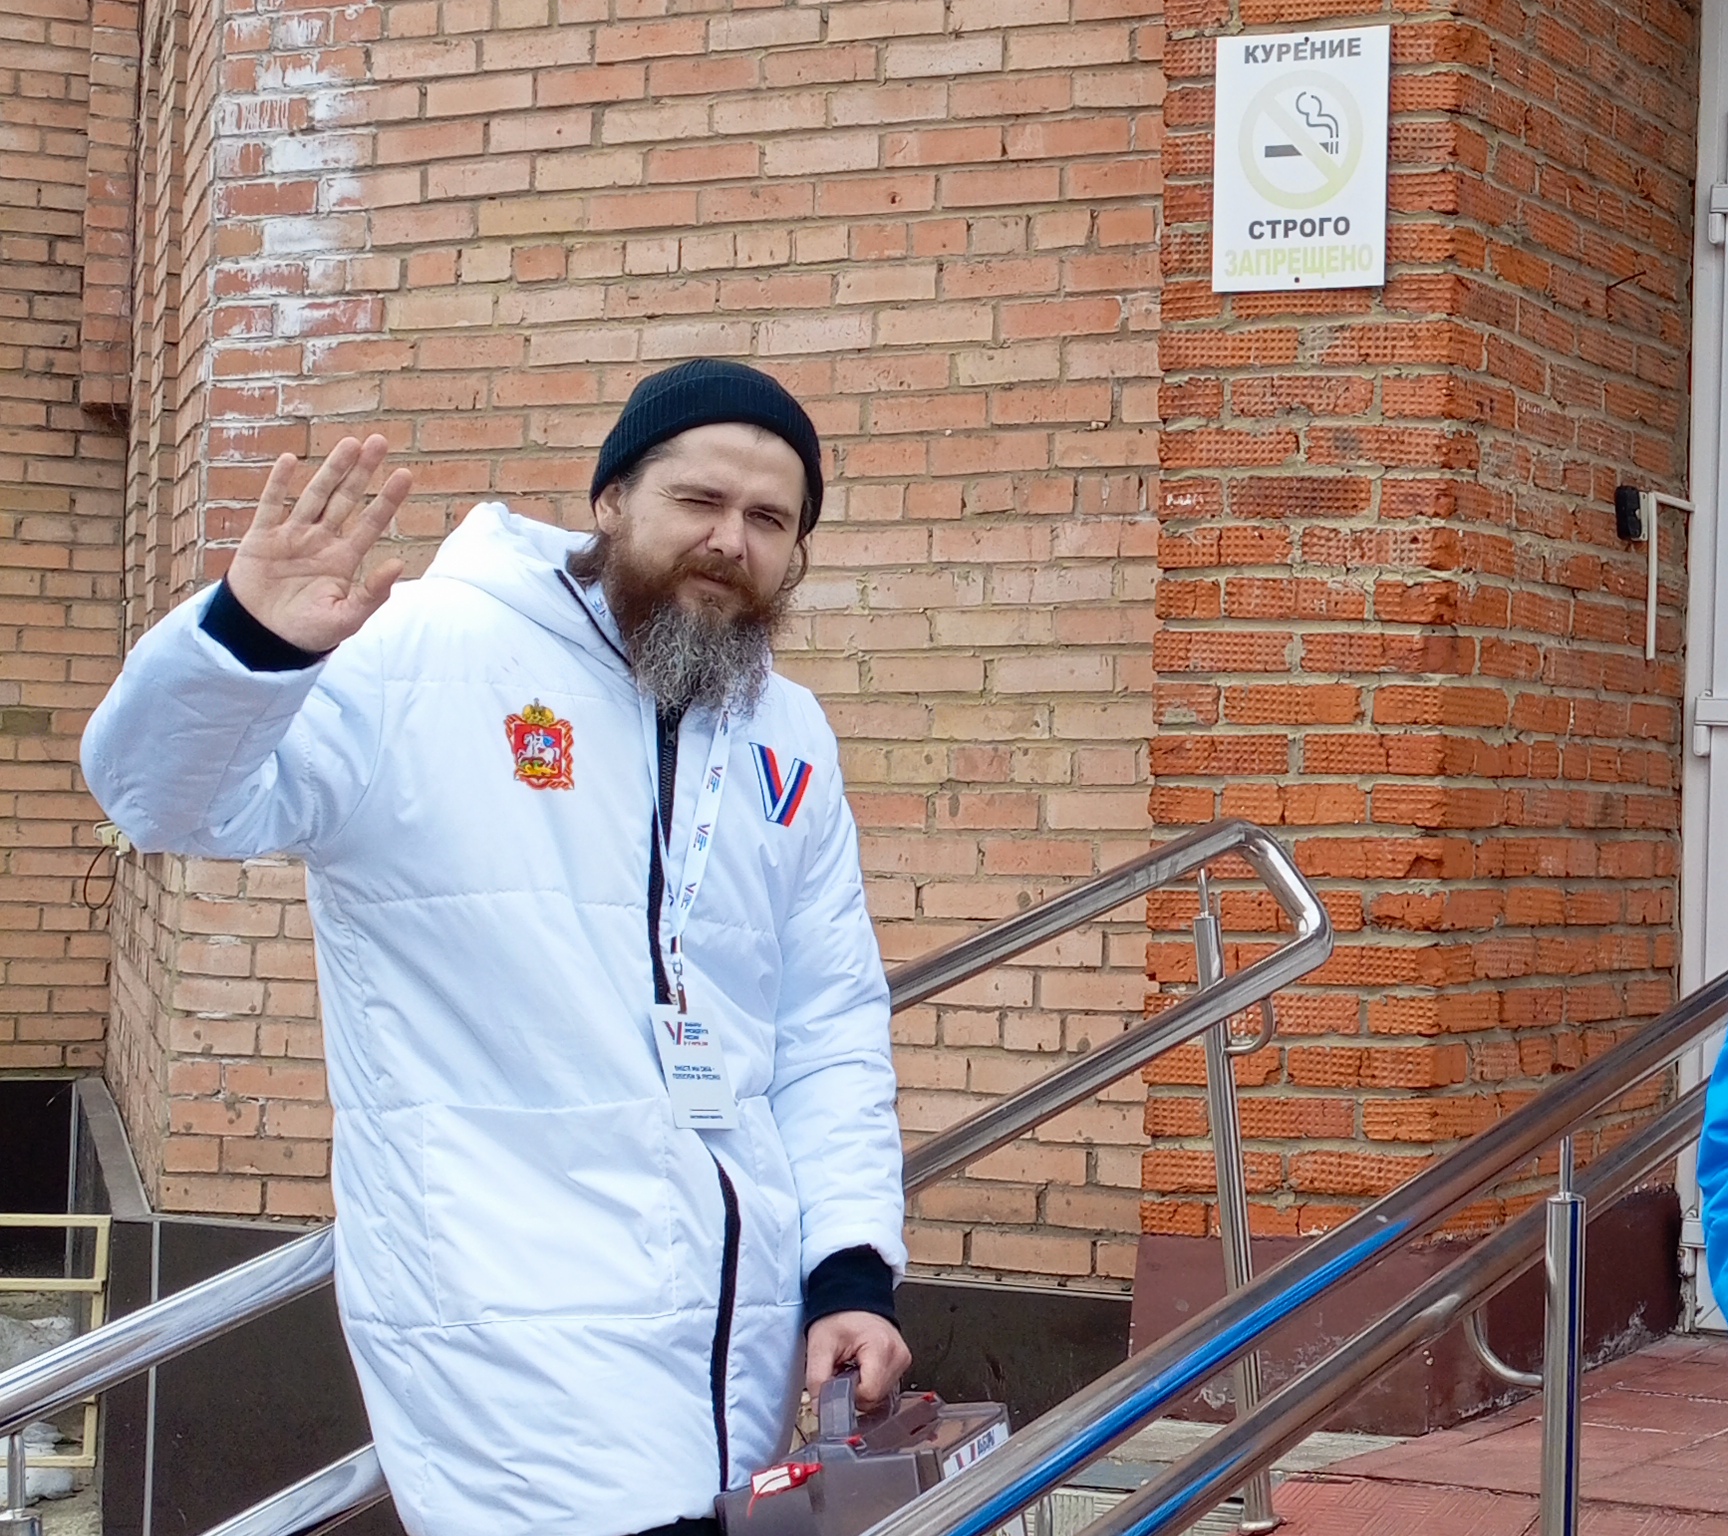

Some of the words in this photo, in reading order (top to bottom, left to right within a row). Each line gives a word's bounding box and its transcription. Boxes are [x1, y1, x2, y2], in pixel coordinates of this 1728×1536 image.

[1244, 37, 1362, 64] КУРЕНИЕ
[1248, 216, 1351, 240] СТРОГО
[1224, 243, 1374, 279] ЗАПРЕЩЕНО
